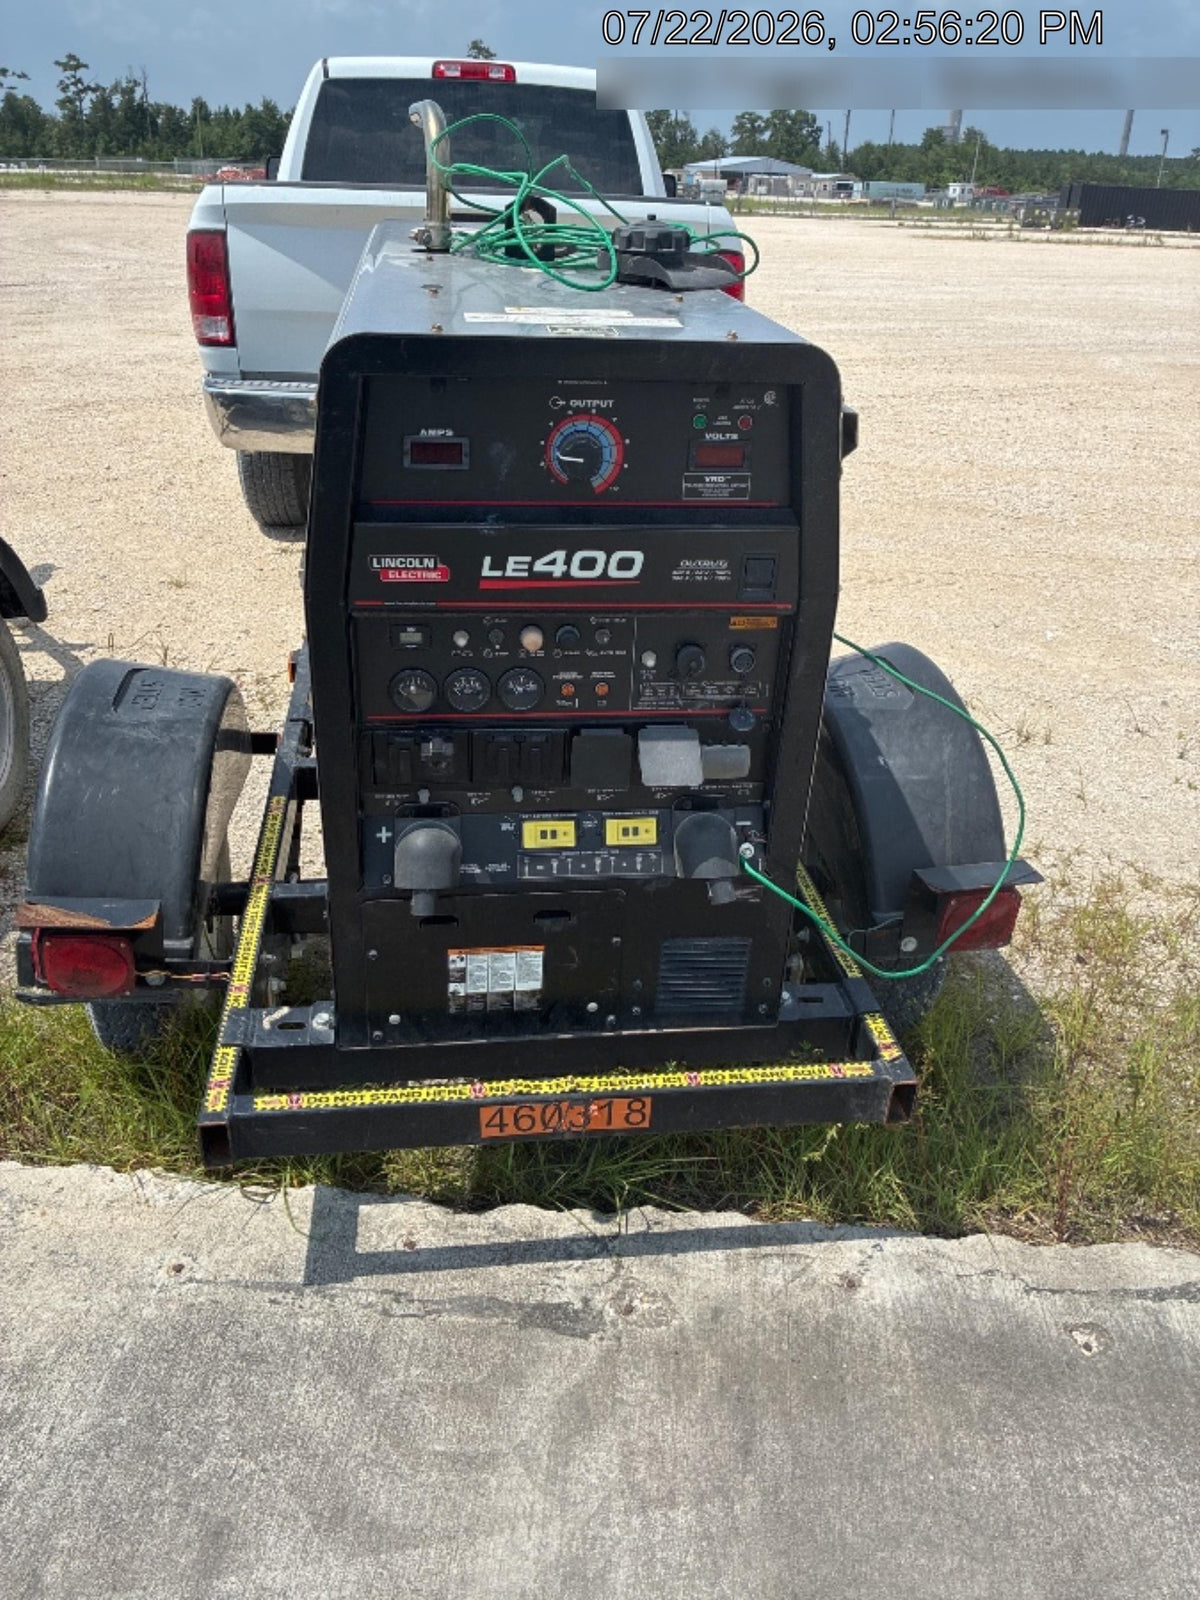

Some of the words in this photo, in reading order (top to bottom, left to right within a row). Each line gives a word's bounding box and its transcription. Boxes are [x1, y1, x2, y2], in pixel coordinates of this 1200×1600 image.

[569, 399, 615, 408] OUTPUT
[420, 428, 454, 437] AMPS
[371, 557, 436, 569] LINCOLN
[481, 549, 646, 579] LE400
[387, 570, 442, 580] ELECTRIC
[662, 1075, 682, 1084] ICI
[703, 1074, 726, 1083] NO
[729, 1073, 748, 1082] SE
[751, 1071, 788, 1080] PARE
[793, 1069, 826, 1078] AQUI
[306, 1095, 330, 1106] DO
[333, 1094, 366, 1104] NOT
[369, 1090, 422, 1102] STAND
[426, 1087, 470, 1098] HERE
